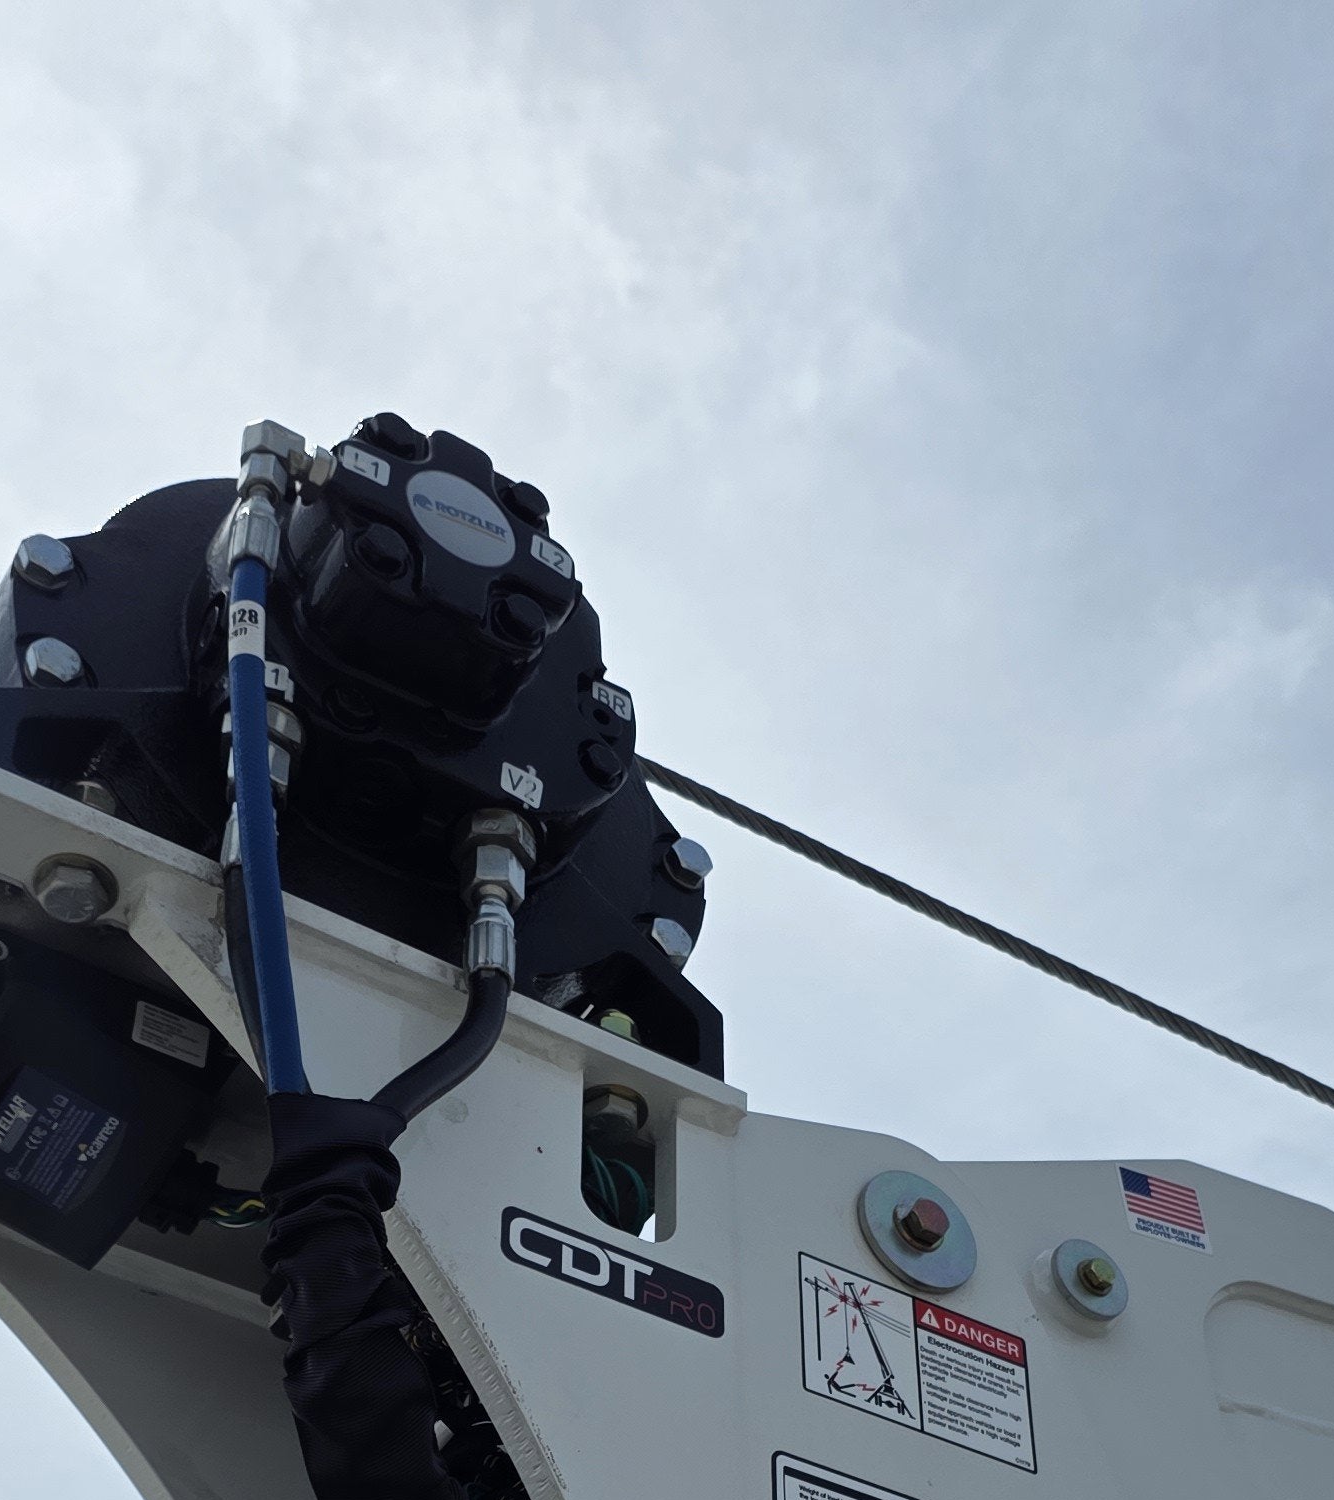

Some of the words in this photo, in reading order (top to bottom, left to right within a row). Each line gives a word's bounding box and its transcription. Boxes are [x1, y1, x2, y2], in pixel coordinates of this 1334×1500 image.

[353, 452, 380, 479] L1
[435, 501, 507, 538] ROTZLER
[539, 542, 565, 571] L2
[598, 686, 627, 715] BR
[508, 768, 537, 803] V2
[945, 1317, 1018, 1357] DANGER
[928, 1336, 982, 1363] Electrocution
[986, 1358, 1014, 1375] Hazard
